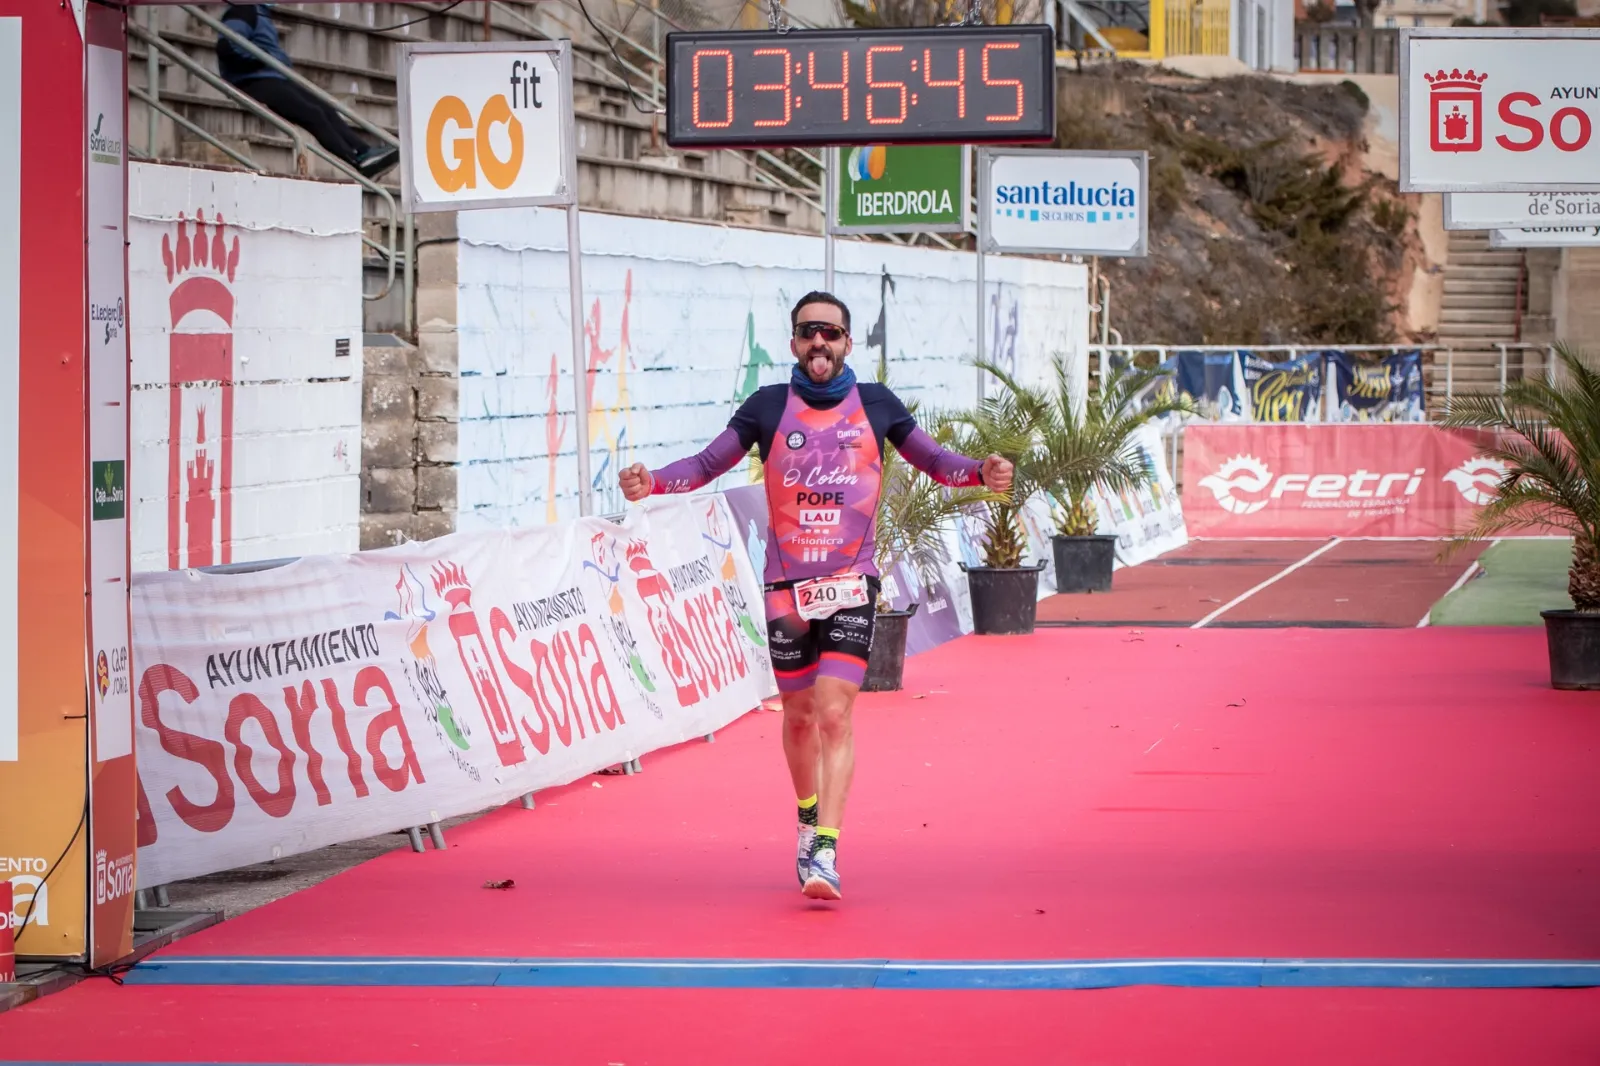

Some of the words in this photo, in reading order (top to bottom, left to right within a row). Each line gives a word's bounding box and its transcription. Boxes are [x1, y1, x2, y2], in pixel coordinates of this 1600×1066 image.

[510, 60, 542, 108] fit
[692, 42, 1024, 129] 03:46:45
[1550, 87, 1600, 99] AYUN
[1495, 91, 1592, 152] So
[426, 94, 524, 192] GO
[857, 189, 953, 217] IBERDROLA
[996, 181, 1135, 207] santalucía
[1529, 199, 1549, 215] de
[1555, 200, 1600, 215] Soria
[1041, 211, 1084, 222] SEGUROS
[796, 492, 844, 505] POPE
[805, 513, 834, 522] LAU
[803, 587, 837, 606] 240
[206, 623, 380, 689] AYUNTAMIENTO
[490, 607, 626, 755] Soria
[138, 664, 426, 833] Soria
[107, 860, 133, 900] Soria
